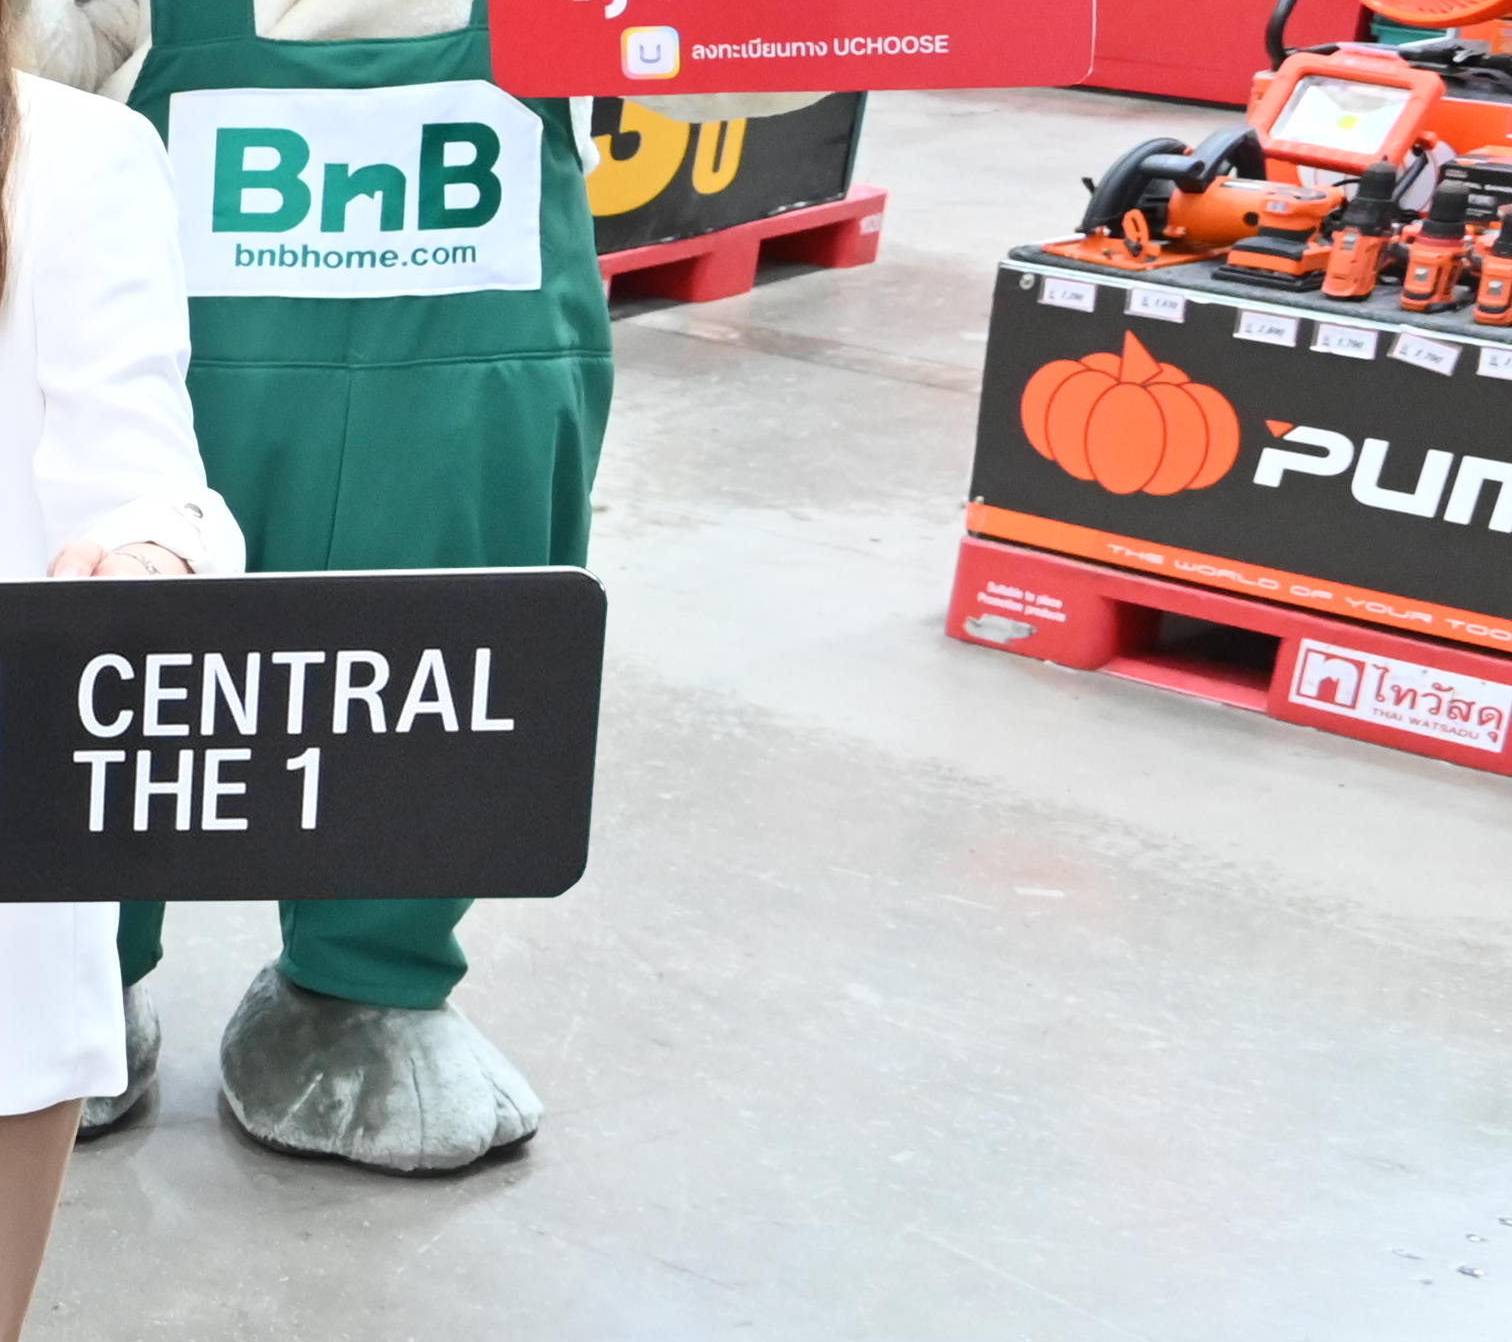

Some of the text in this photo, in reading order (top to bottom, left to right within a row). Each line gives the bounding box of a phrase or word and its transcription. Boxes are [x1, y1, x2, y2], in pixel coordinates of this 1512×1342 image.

[690, 33, 949, 63] ลงทะเบียนทาง UCHOOSE
[211, 121, 503, 233] BnB
[234, 242, 477, 270] bnbhome.com
[1106, 543, 1166, 566] THE
[1173, 558, 1280, 592] WORLD
[1289, 584, 1335, 602] OF
[1344, 595, 1434, 625] YOUR
[76, 647, 516, 737] CENTRAL
[1370, 706, 1481, 742] THAI WATSADU
[1372, 663, 1503, 745] ไทวัสดุ
[73, 747, 321, 832] THE 1
